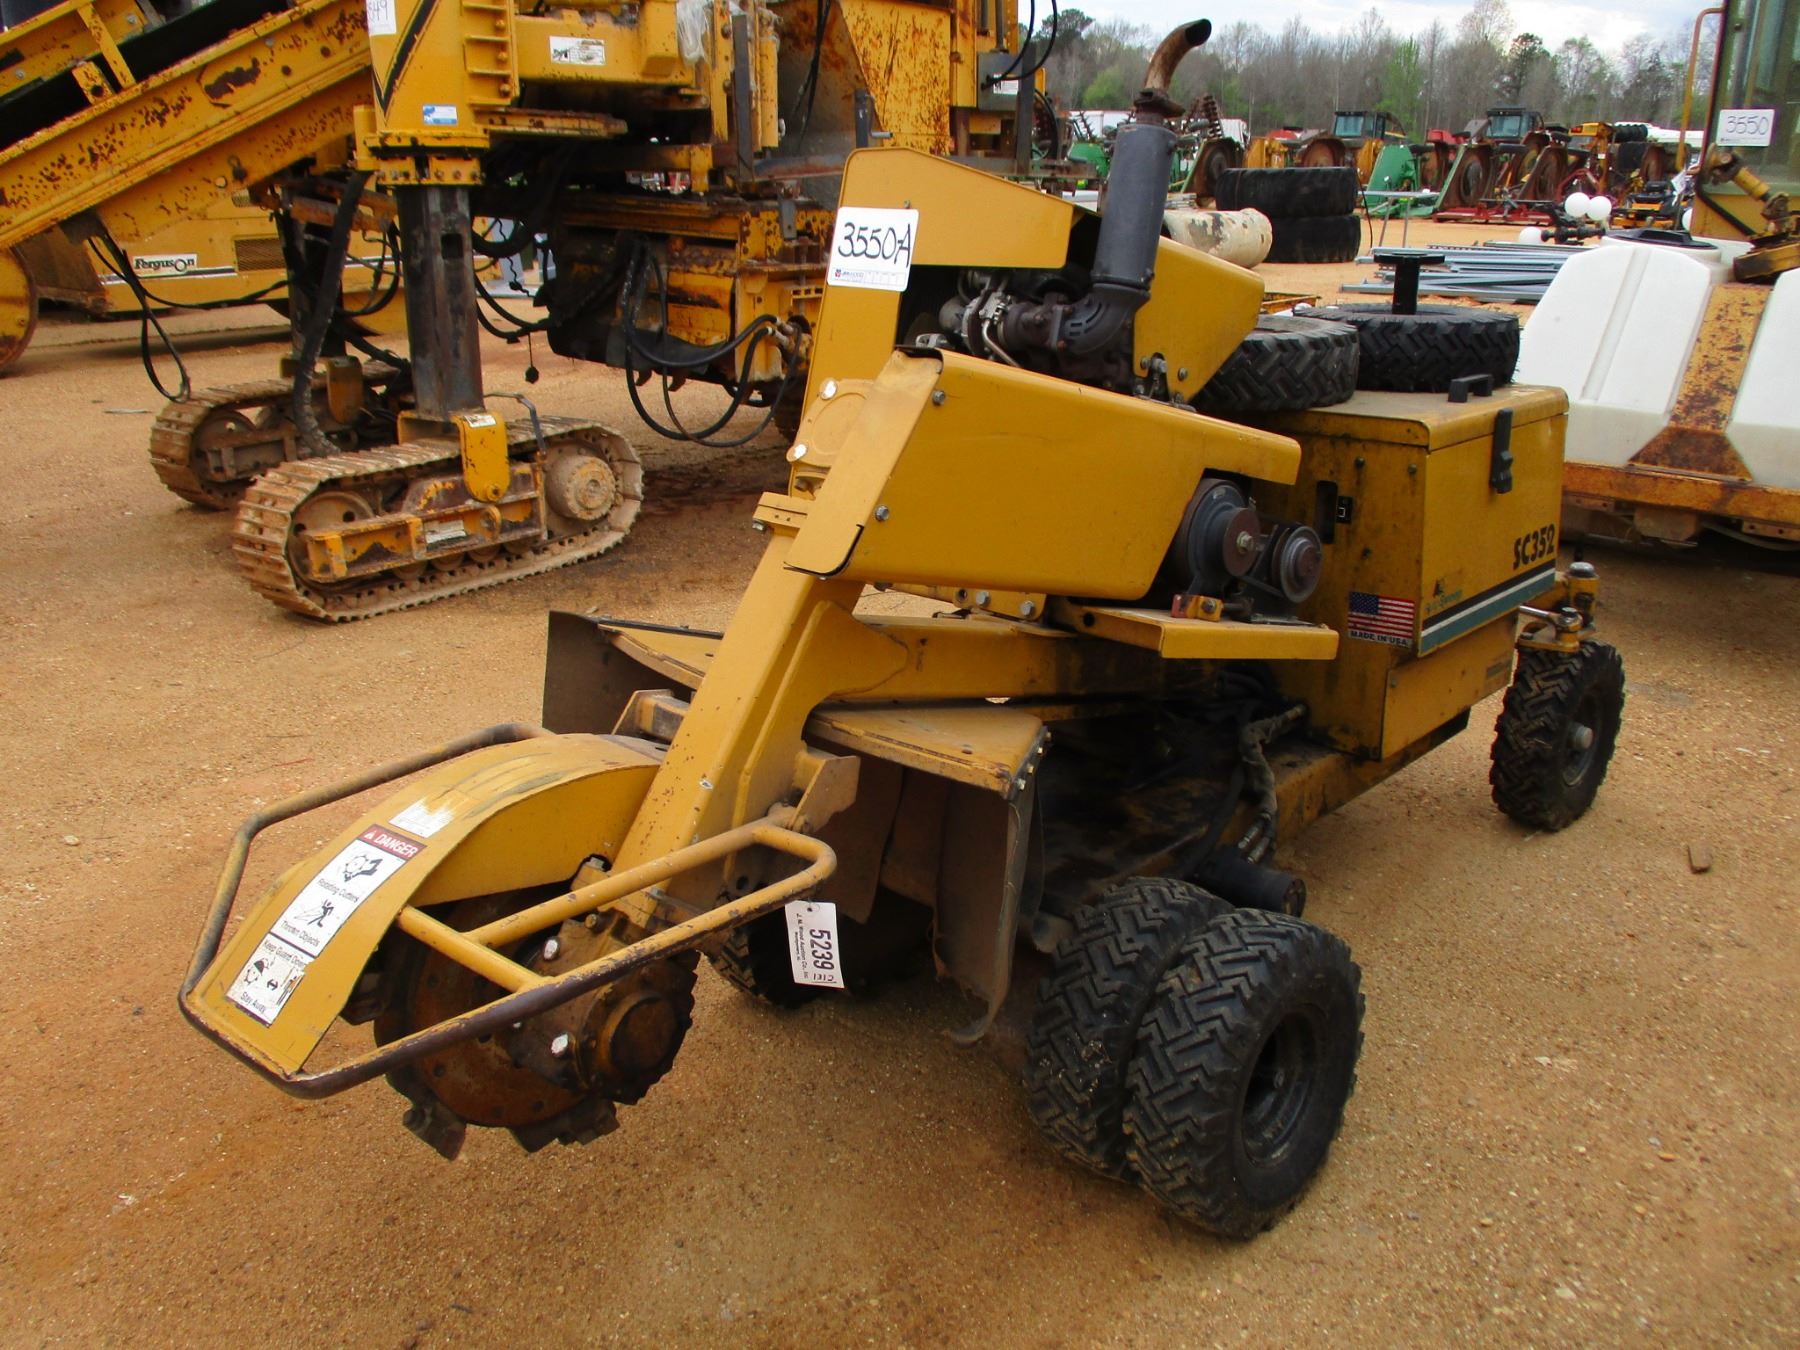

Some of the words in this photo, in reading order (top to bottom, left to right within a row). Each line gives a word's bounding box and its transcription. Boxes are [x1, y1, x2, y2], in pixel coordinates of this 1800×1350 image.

[1727, 115, 1769, 135] 3550
[1513, 523, 1555, 571] SC352
[1351, 630, 1375, 640] MADE
[374, 833, 419, 858] DANGER
[318, 878, 340, 896] Rotating
[281, 920, 300, 937] Thrown
[299, 929, 320, 948] Objects
[809, 929, 835, 971] 5239
